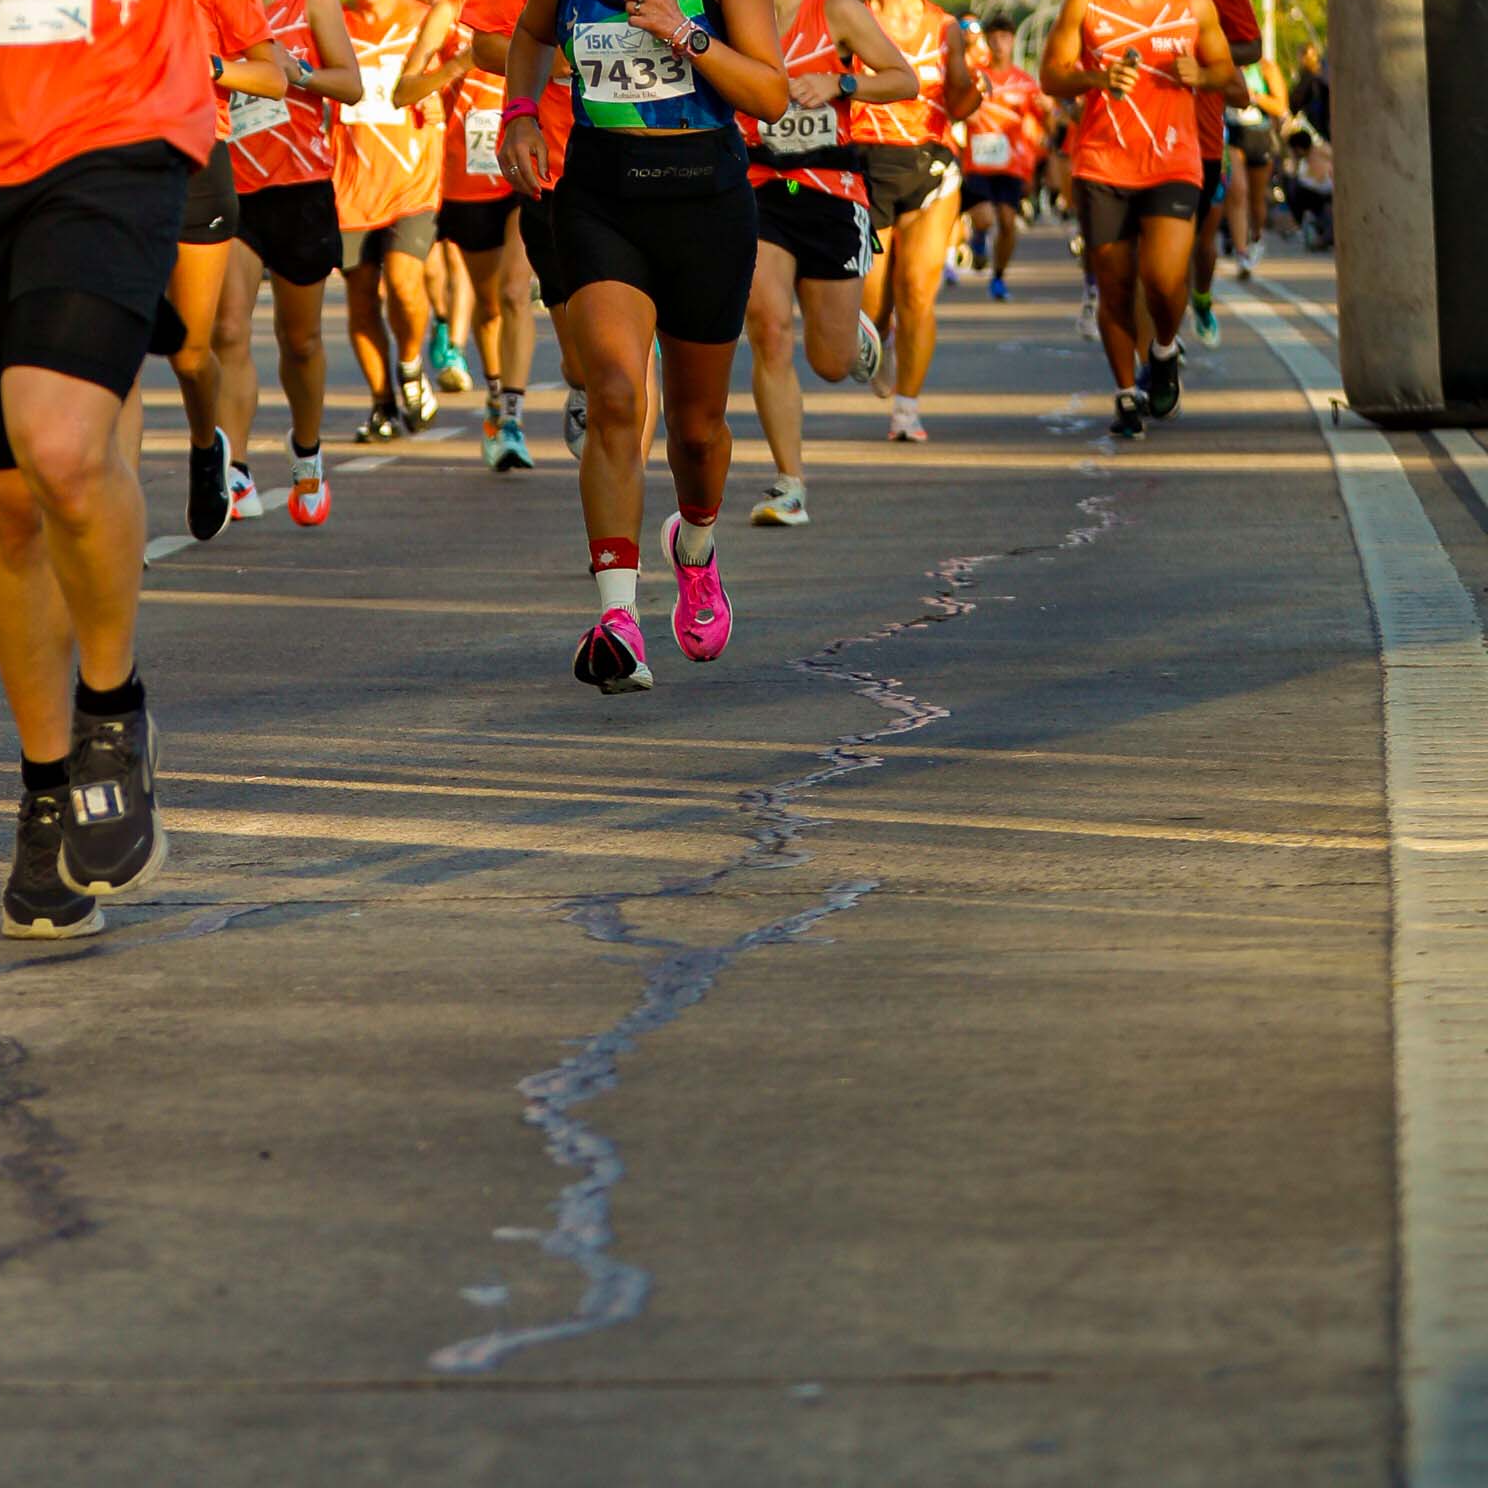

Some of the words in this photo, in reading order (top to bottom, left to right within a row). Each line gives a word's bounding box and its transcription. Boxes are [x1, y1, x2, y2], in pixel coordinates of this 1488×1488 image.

[584, 34, 613, 50] 15K
[580, 55, 686, 90] 7433
[763, 114, 832, 138] 1901
